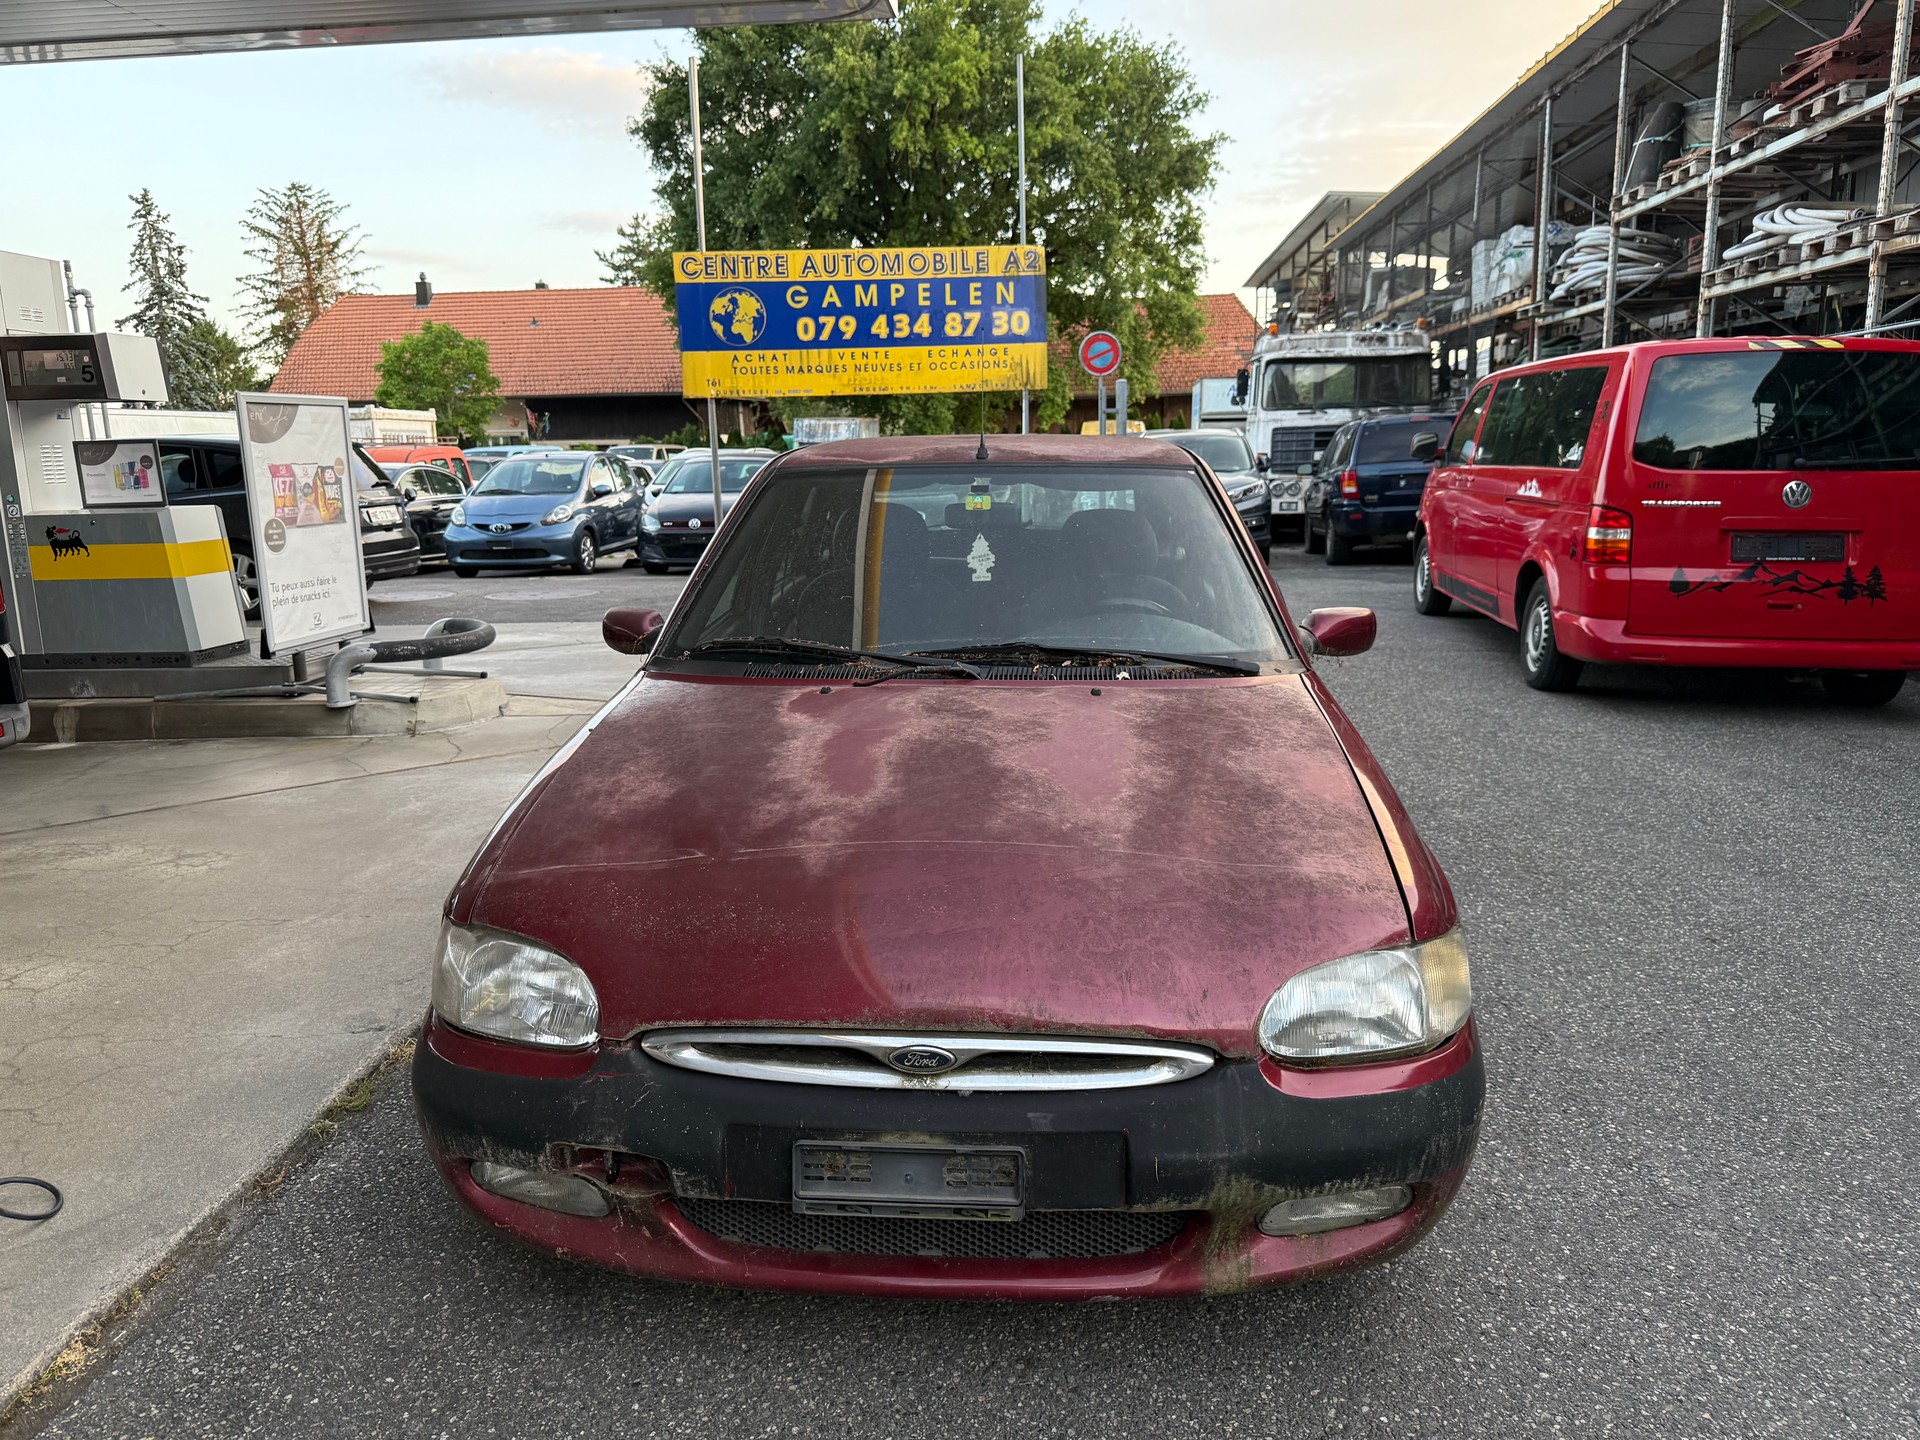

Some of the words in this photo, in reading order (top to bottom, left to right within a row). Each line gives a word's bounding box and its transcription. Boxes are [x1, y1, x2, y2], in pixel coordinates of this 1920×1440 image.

[680, 254, 788, 280] CENTRE
[799, 249, 988, 278] AUTOMOBILE
[1001, 250, 1040, 273] A2
[786, 281, 1015, 309] GAMPELEN
[796, 315, 857, 342] 079
[871, 312, 932, 339] 434
[944, 311, 982, 337] 87
[992, 310, 1030, 336] 30
[732, 353, 788, 363] ACHAT
[838, 351, 890, 361] VENTE
[928, 347, 1009, 358] ECHANGE
[82, 365, 95, 383] 5
[732, 366, 779, 375] TOUTES
[786, 364, 848, 375] MARQUES
[854, 363, 902, 373] NEUVES
[909, 362, 922, 371] ET
[929, 359, 1008, 371] OCCASIONS
[706, 378, 721, 388] Tél
[270, 582, 280, 593] Tu
[281, 581, 298, 594] peux
[300, 577, 315, 589] aussi
[316, 576, 331, 587] faire
[331, 575, 337, 584] le
[272, 597, 290, 609] plein
[291, 594, 299, 604] de
[300, 590, 321, 603] snacks
[903, 1051, 939, 1067] Ford
